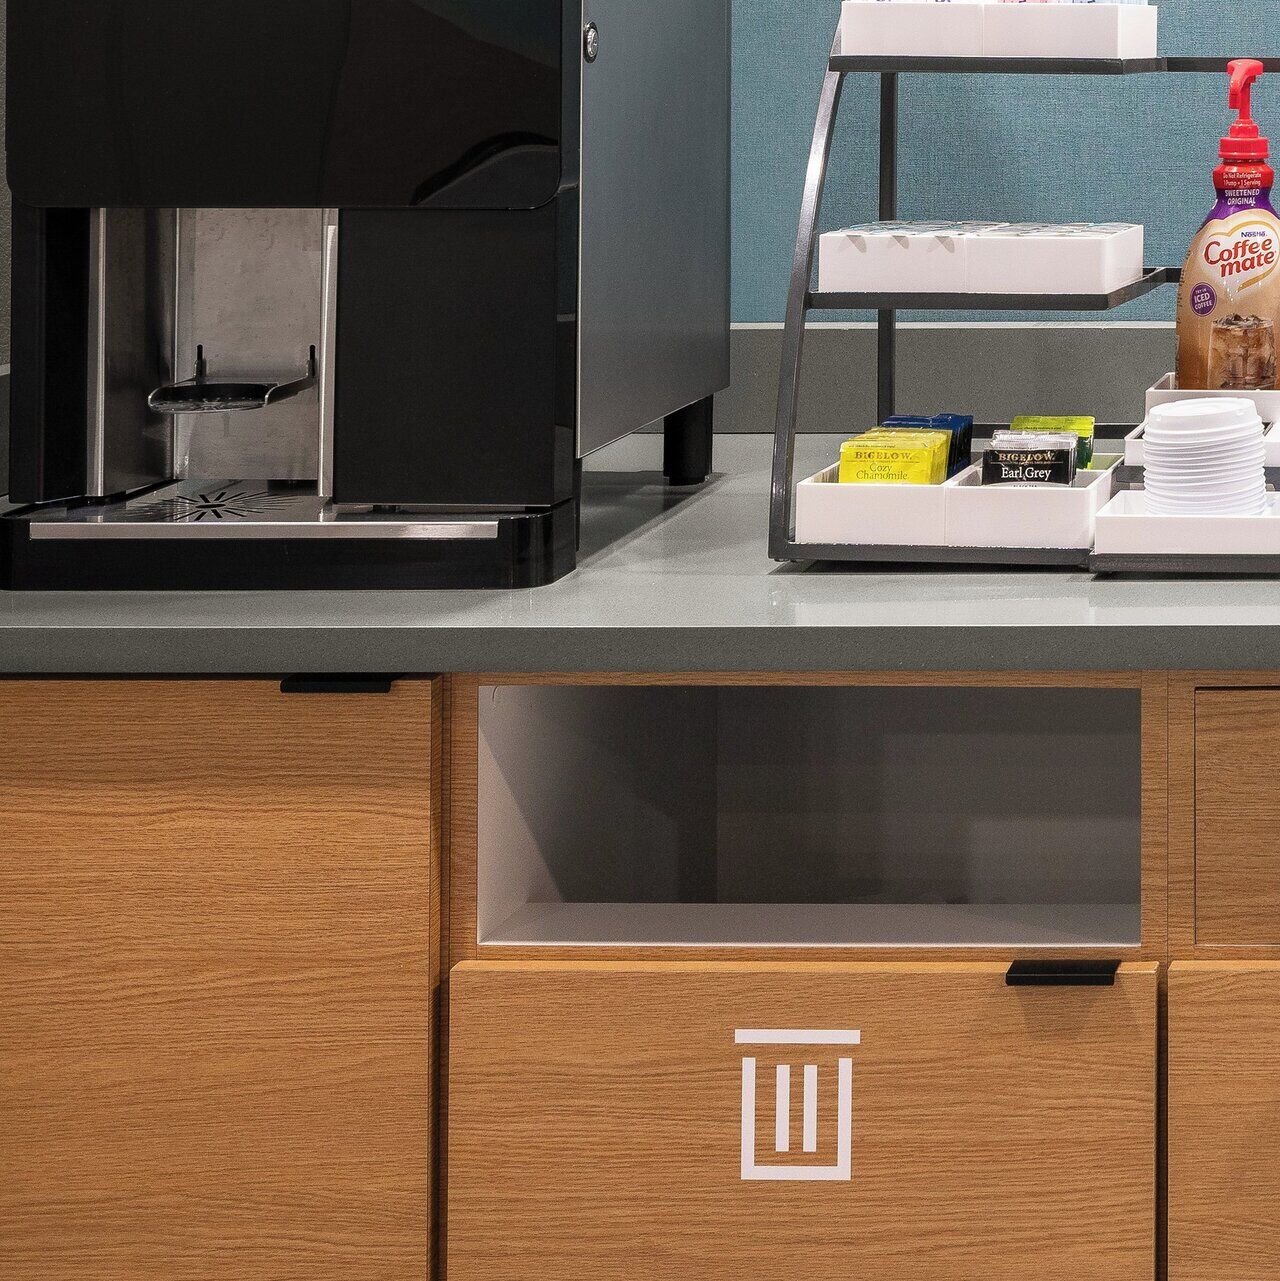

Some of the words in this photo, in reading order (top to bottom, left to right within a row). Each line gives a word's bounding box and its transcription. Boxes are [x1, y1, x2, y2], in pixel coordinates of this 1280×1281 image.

[1204, 239, 1272, 265] Coffee
[1221, 251, 1275, 277] mate
[1194, 293, 1210, 303] ICED
[1195, 300, 1212, 309] COFFEE
[999, 453, 1055, 461] BIGELOW
[870, 463, 892, 472] Cozy
[856, 470, 908, 480] Chamomile
[1001, 467, 1022, 478] Earl
[1025, 467, 1051, 480] Grey
